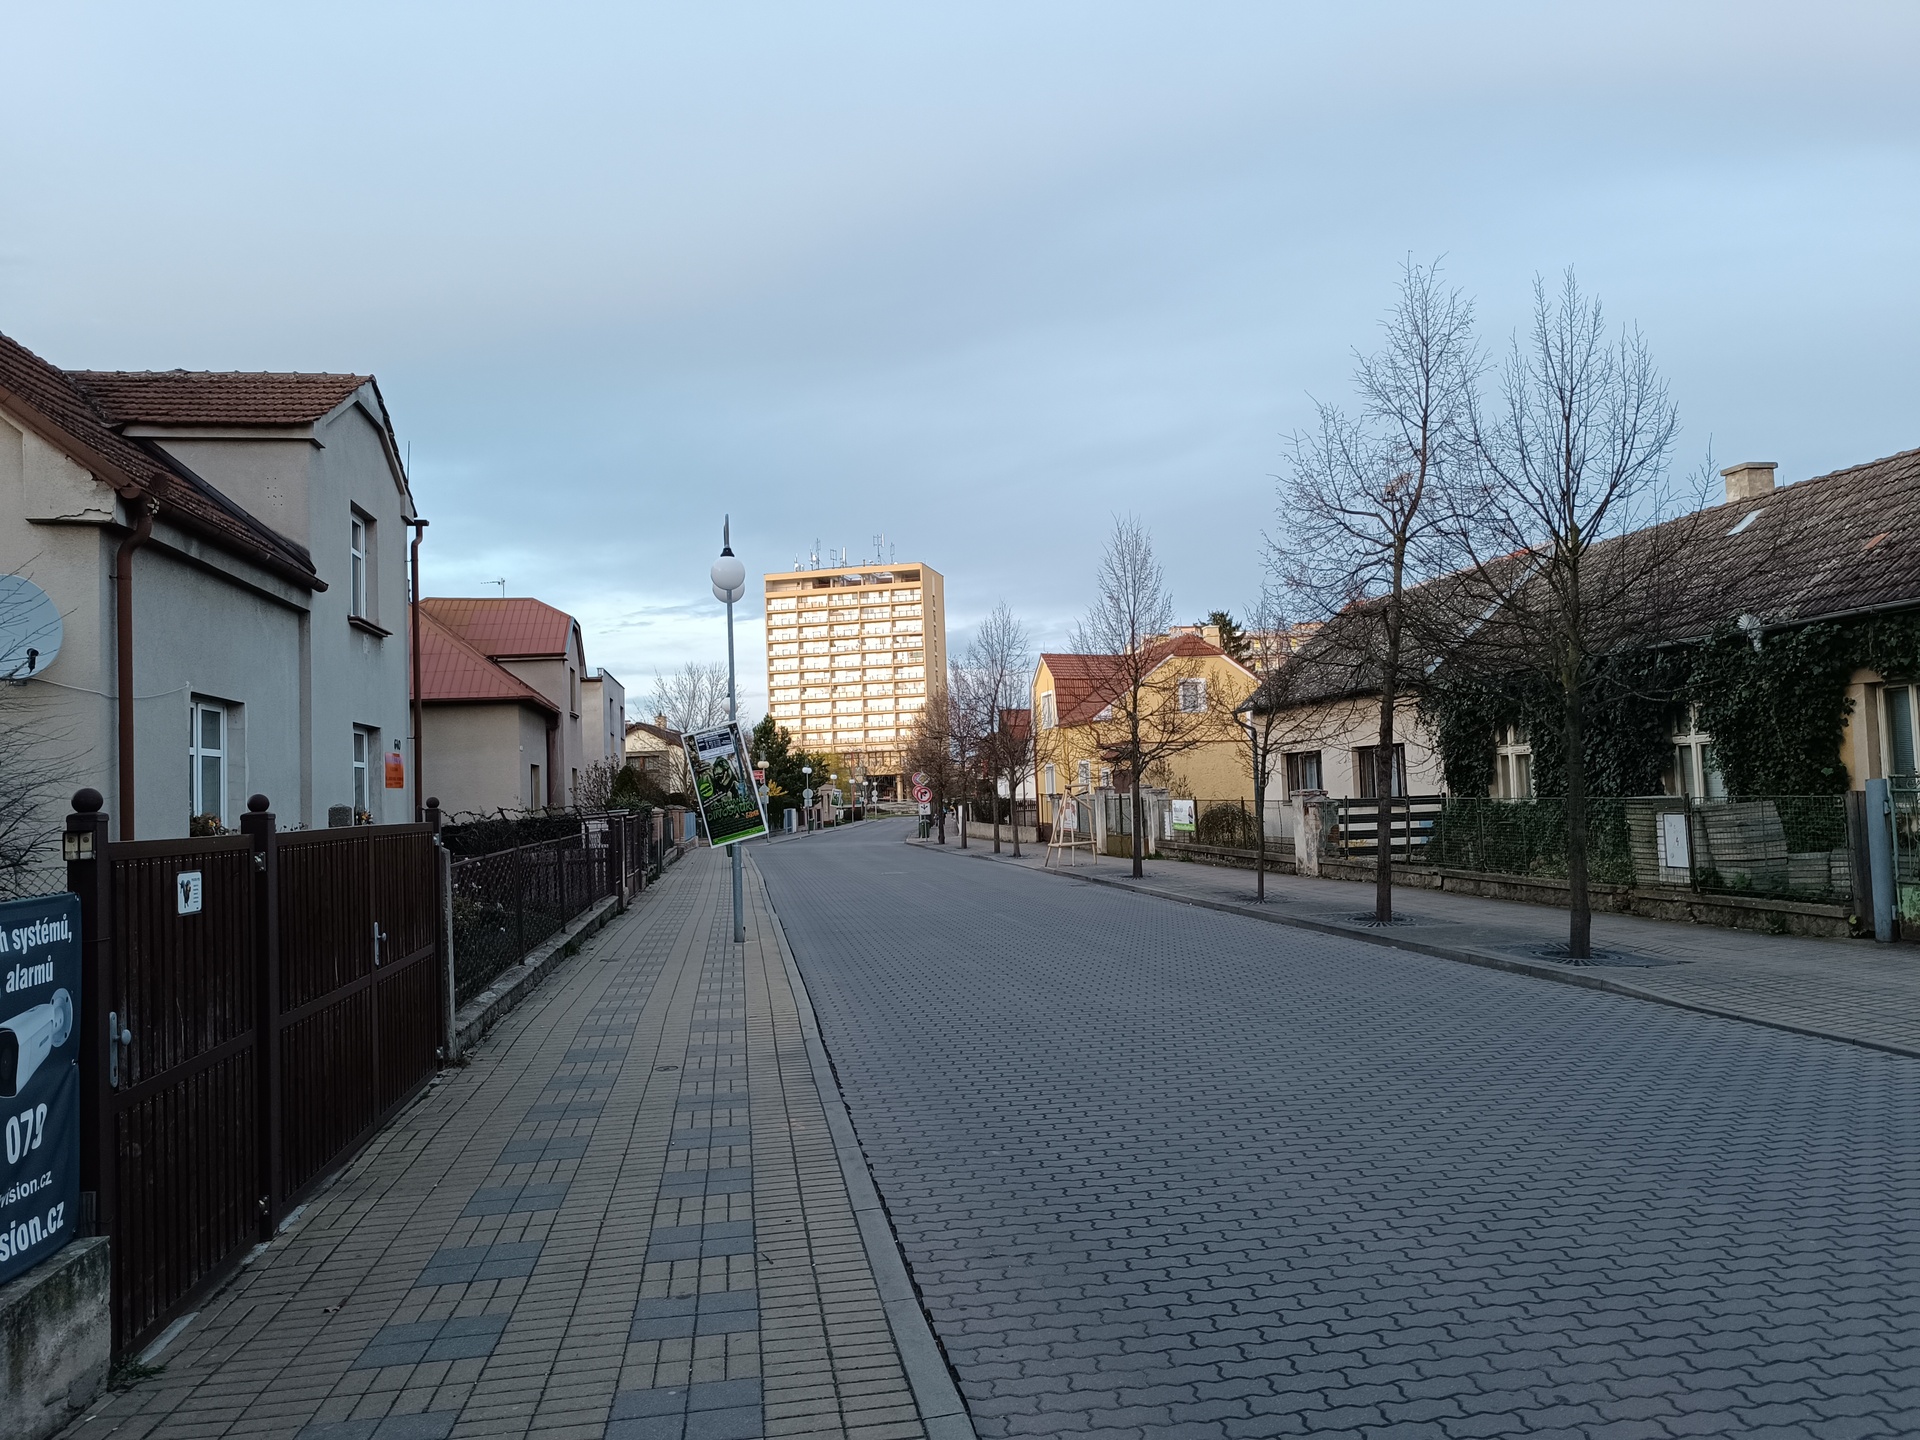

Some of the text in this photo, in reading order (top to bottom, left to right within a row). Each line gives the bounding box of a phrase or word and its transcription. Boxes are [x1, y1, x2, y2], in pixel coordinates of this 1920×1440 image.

[707, 801, 756, 821] DINOSAURY
[12, 913, 72, 954] systémů,
[6, 955, 53, 993] alarmů
